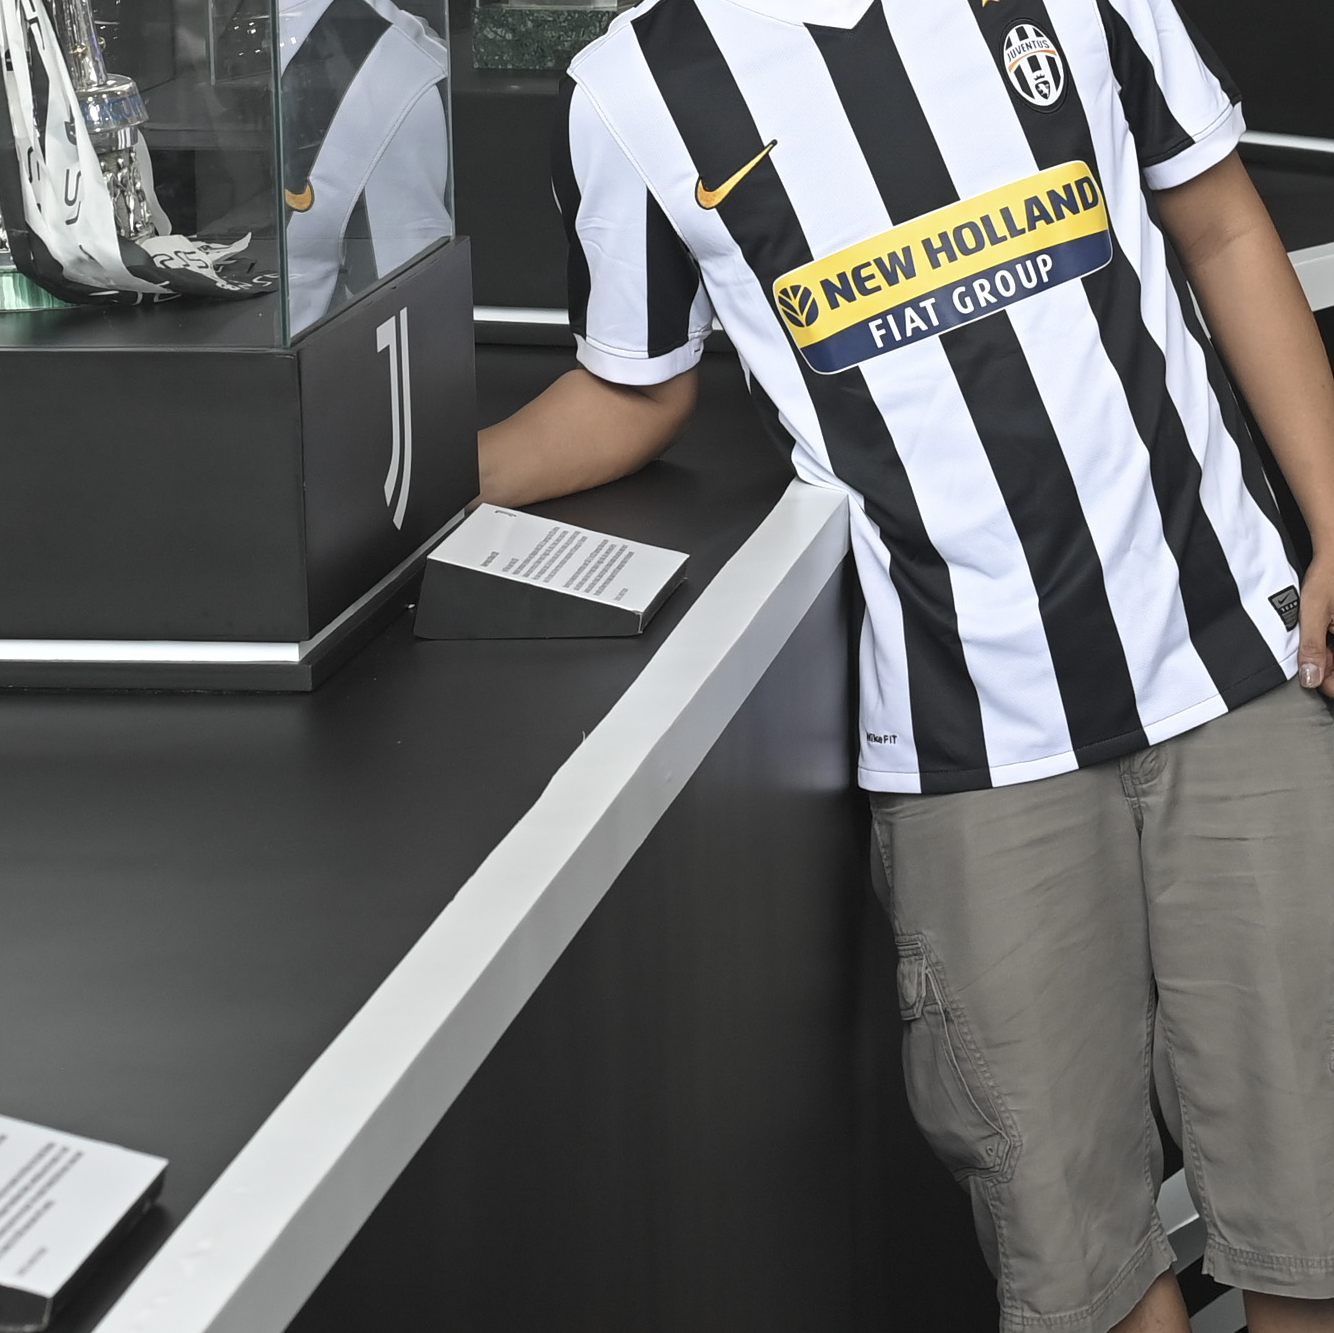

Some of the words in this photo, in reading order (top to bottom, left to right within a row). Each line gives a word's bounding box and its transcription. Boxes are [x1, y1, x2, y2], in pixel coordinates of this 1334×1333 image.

[1006, 39, 1051, 64] JUVENTUS
[820, 245, 917, 311] NEW
[921, 175, 1100, 270] HOLLAND
[868, 297, 940, 350] FIAT
[951, 253, 1054, 315] GROUP
